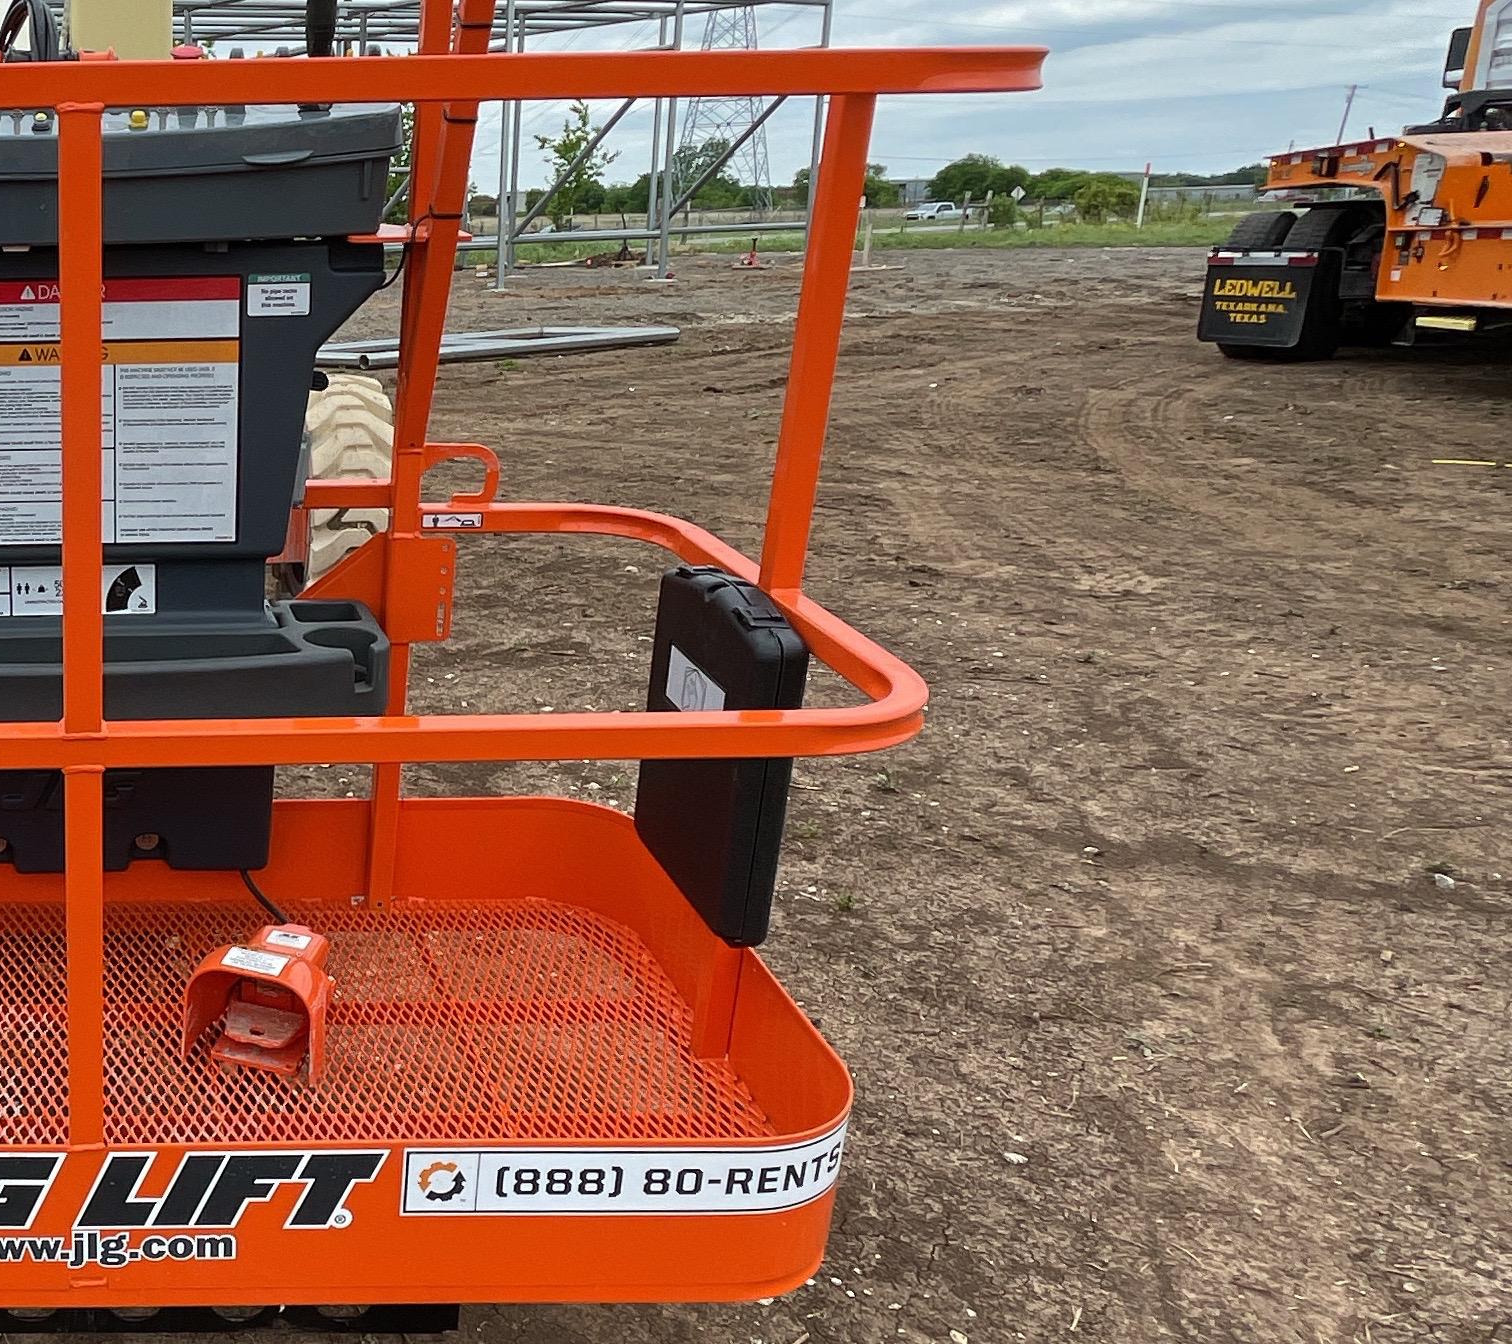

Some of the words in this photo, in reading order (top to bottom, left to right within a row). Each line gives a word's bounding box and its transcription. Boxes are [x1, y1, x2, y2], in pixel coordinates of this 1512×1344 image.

[1214, 279, 1296, 298] LEDWELL
[1229, 313, 1267, 324] TEXAS
[495, 1165, 624, 1198] (888)
[642, 1141, 842, 1196] 80-RENTS
[74, 1152, 389, 1229] LIFT
